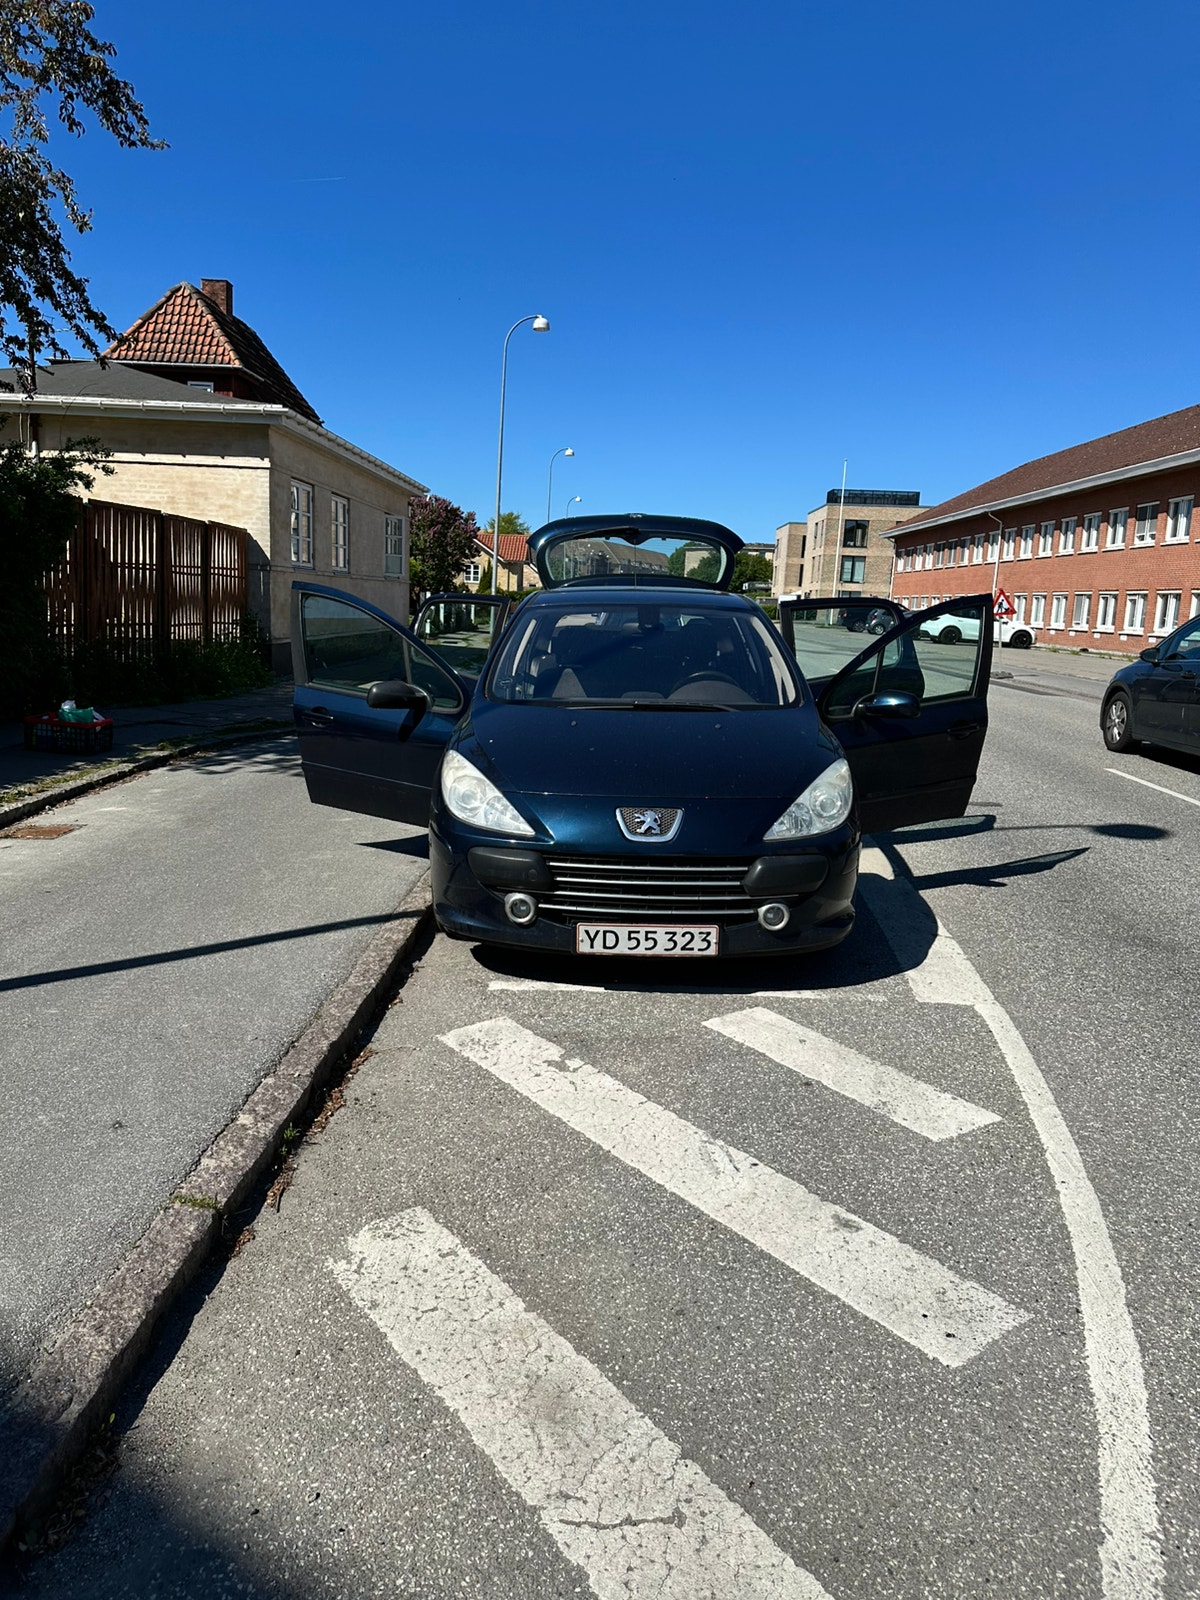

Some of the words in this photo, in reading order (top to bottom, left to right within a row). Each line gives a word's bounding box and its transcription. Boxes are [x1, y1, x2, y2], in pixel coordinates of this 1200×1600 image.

[584, 929, 620, 950] YD
[627, 930, 658, 951] 55
[663, 931, 712, 952] 323
